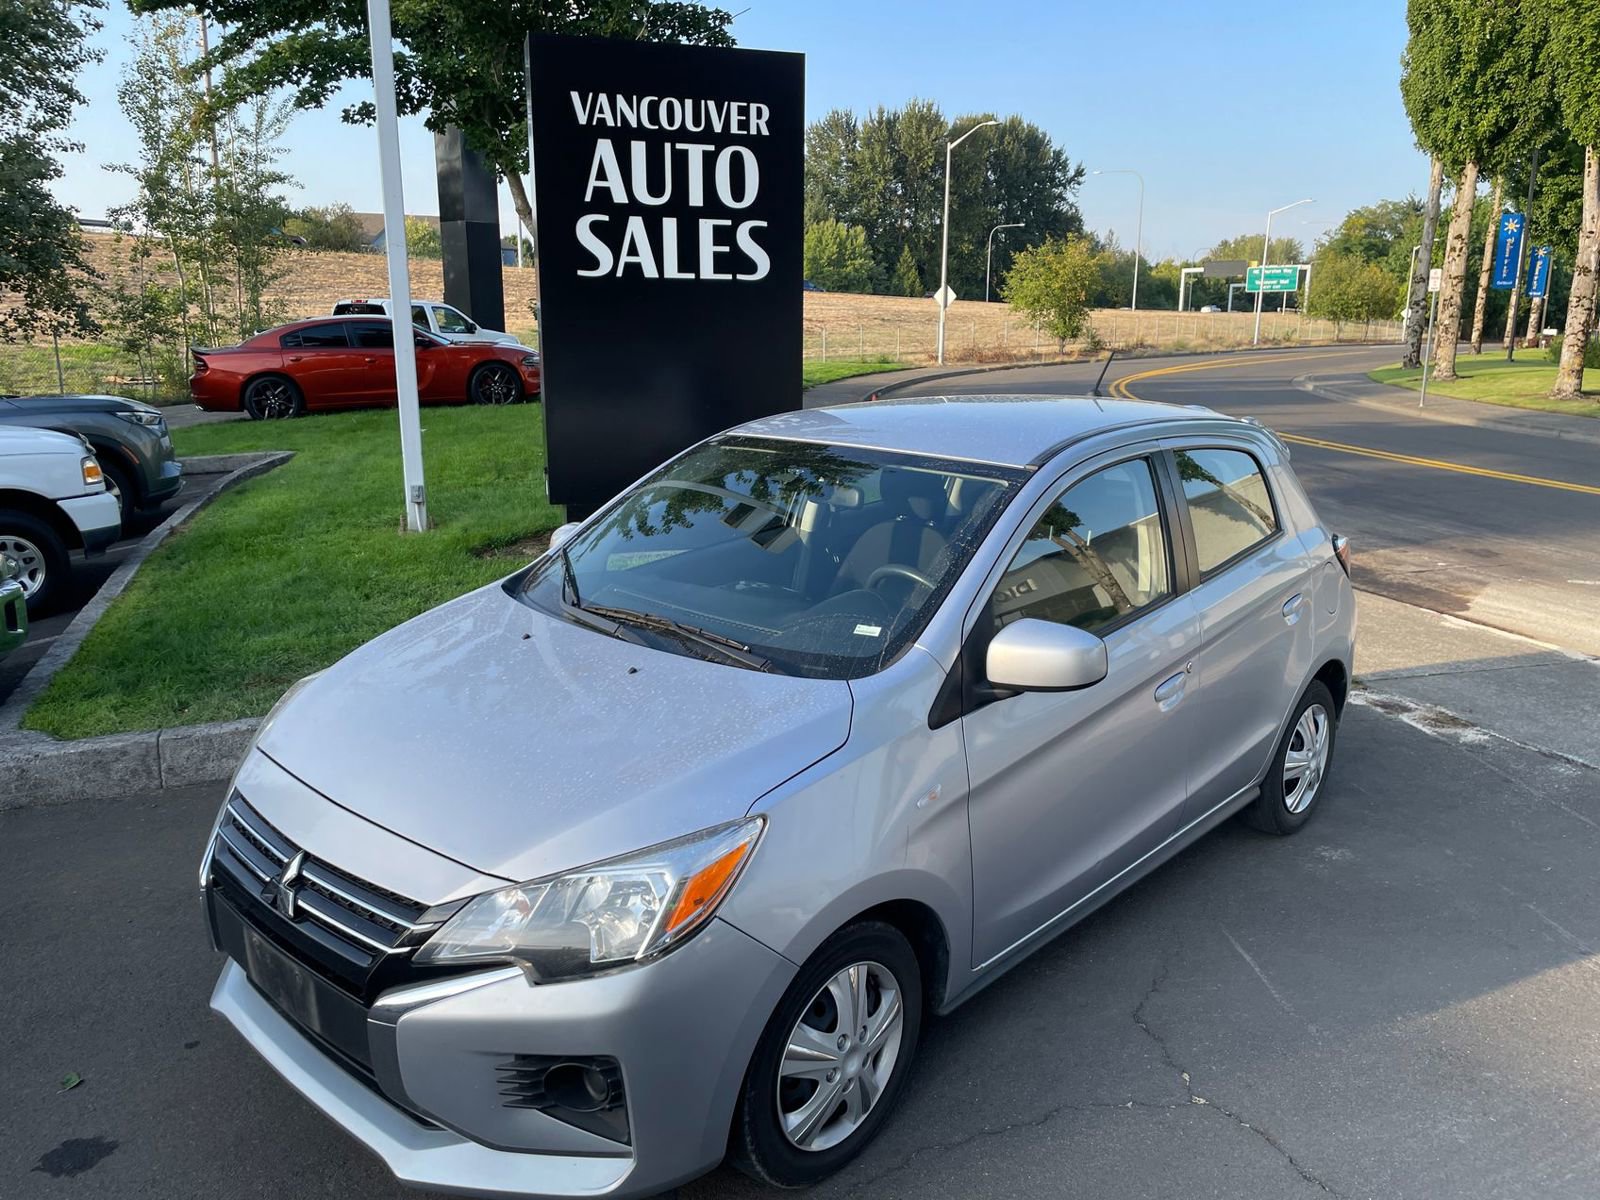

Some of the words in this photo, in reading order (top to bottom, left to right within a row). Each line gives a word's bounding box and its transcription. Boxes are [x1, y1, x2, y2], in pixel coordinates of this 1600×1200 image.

[570, 91, 770, 136] VANCOUVER
[584, 138, 760, 209] AUTO
[575, 213, 771, 281] SALES
